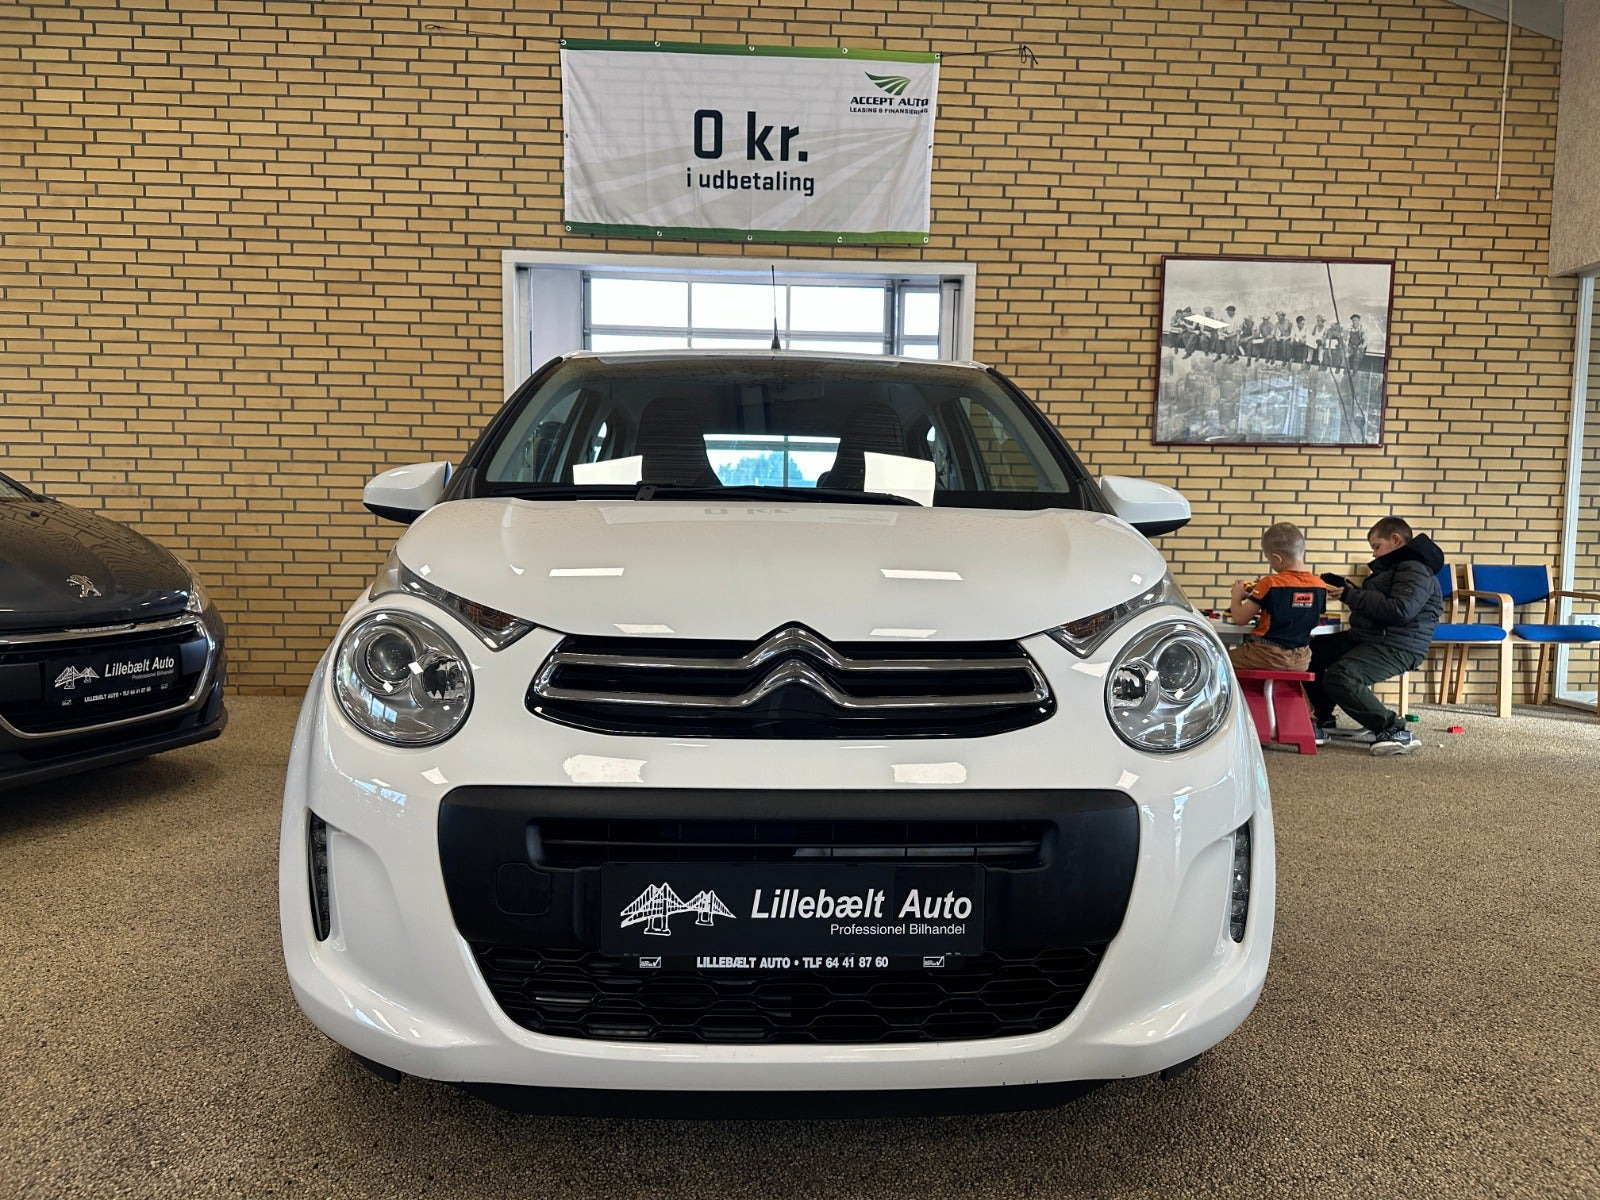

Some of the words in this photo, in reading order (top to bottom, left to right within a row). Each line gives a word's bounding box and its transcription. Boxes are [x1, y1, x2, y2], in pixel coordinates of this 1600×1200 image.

[850, 96, 894, 106] ACCEPT
[898, 98, 929, 107] AUTO
[746, 111, 808, 162] kr.
[686, 168, 691, 188] i
[699, 170, 815, 197] udbetaling
[104, 658, 150, 678] Lillebælt
[151, 656, 175, 670] Auto
[750, 888, 885, 919] Lillebælt
[898, 888, 972, 919] Auto
[830, 923, 906, 935] Professionel
[909, 922, 966, 935] Bilhandel
[696, 956, 756, 968] LILLEBÆLT
[759, 956, 791, 968] AUTO
[802, 957, 822, 968] TLF
[825, 957, 839, 968] 64
[842, 957, 854, 968] 41
[858, 957, 872, 968] 87
[875, 957, 888, 968] 60
